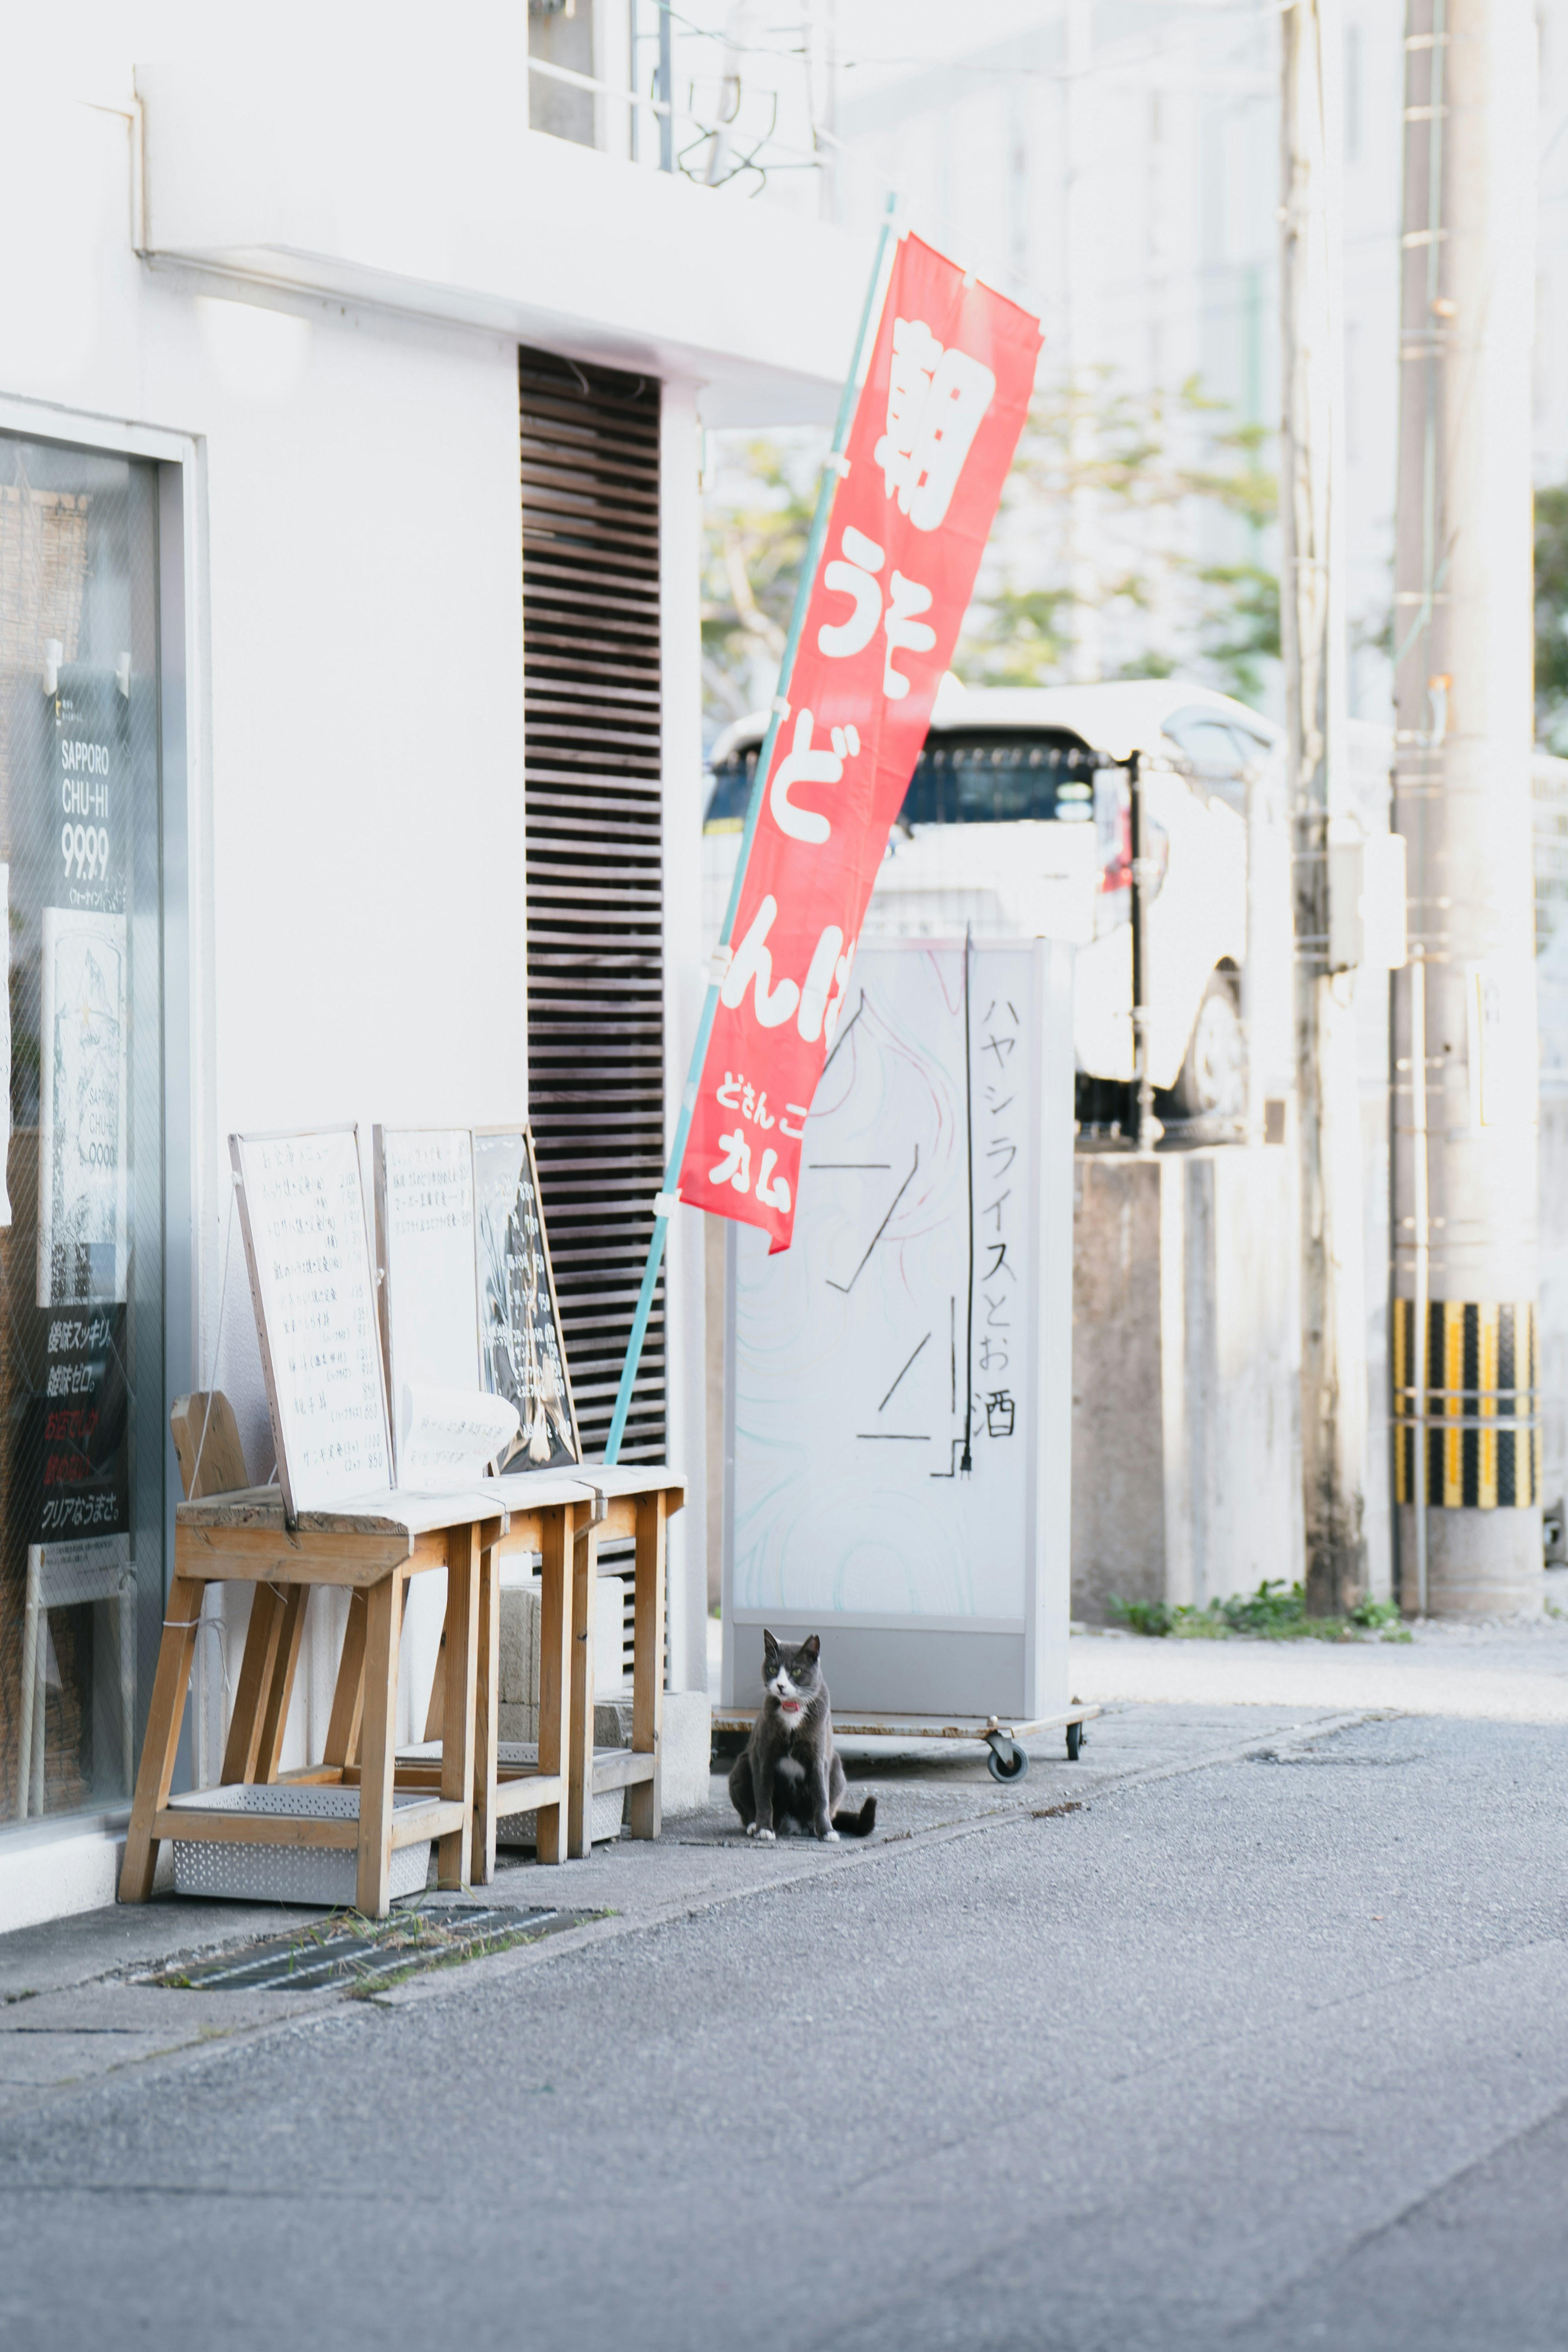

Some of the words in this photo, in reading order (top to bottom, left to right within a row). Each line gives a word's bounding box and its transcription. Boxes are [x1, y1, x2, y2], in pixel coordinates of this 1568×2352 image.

[62, 739, 109, 776] SAPPORO
[721, 526, 885, 1027] うどん
[62, 778, 108, 818] CHU-HI
[717, 1071, 808, 1139] どさんこ
[518, 1181, 534, 1201] 880
[524, 1214, 539, 1236] 780
[972, 1001, 1019, 1438] ハヤシライスとお酒
[42, 1491, 119, 1529] クリアなうまさ。
